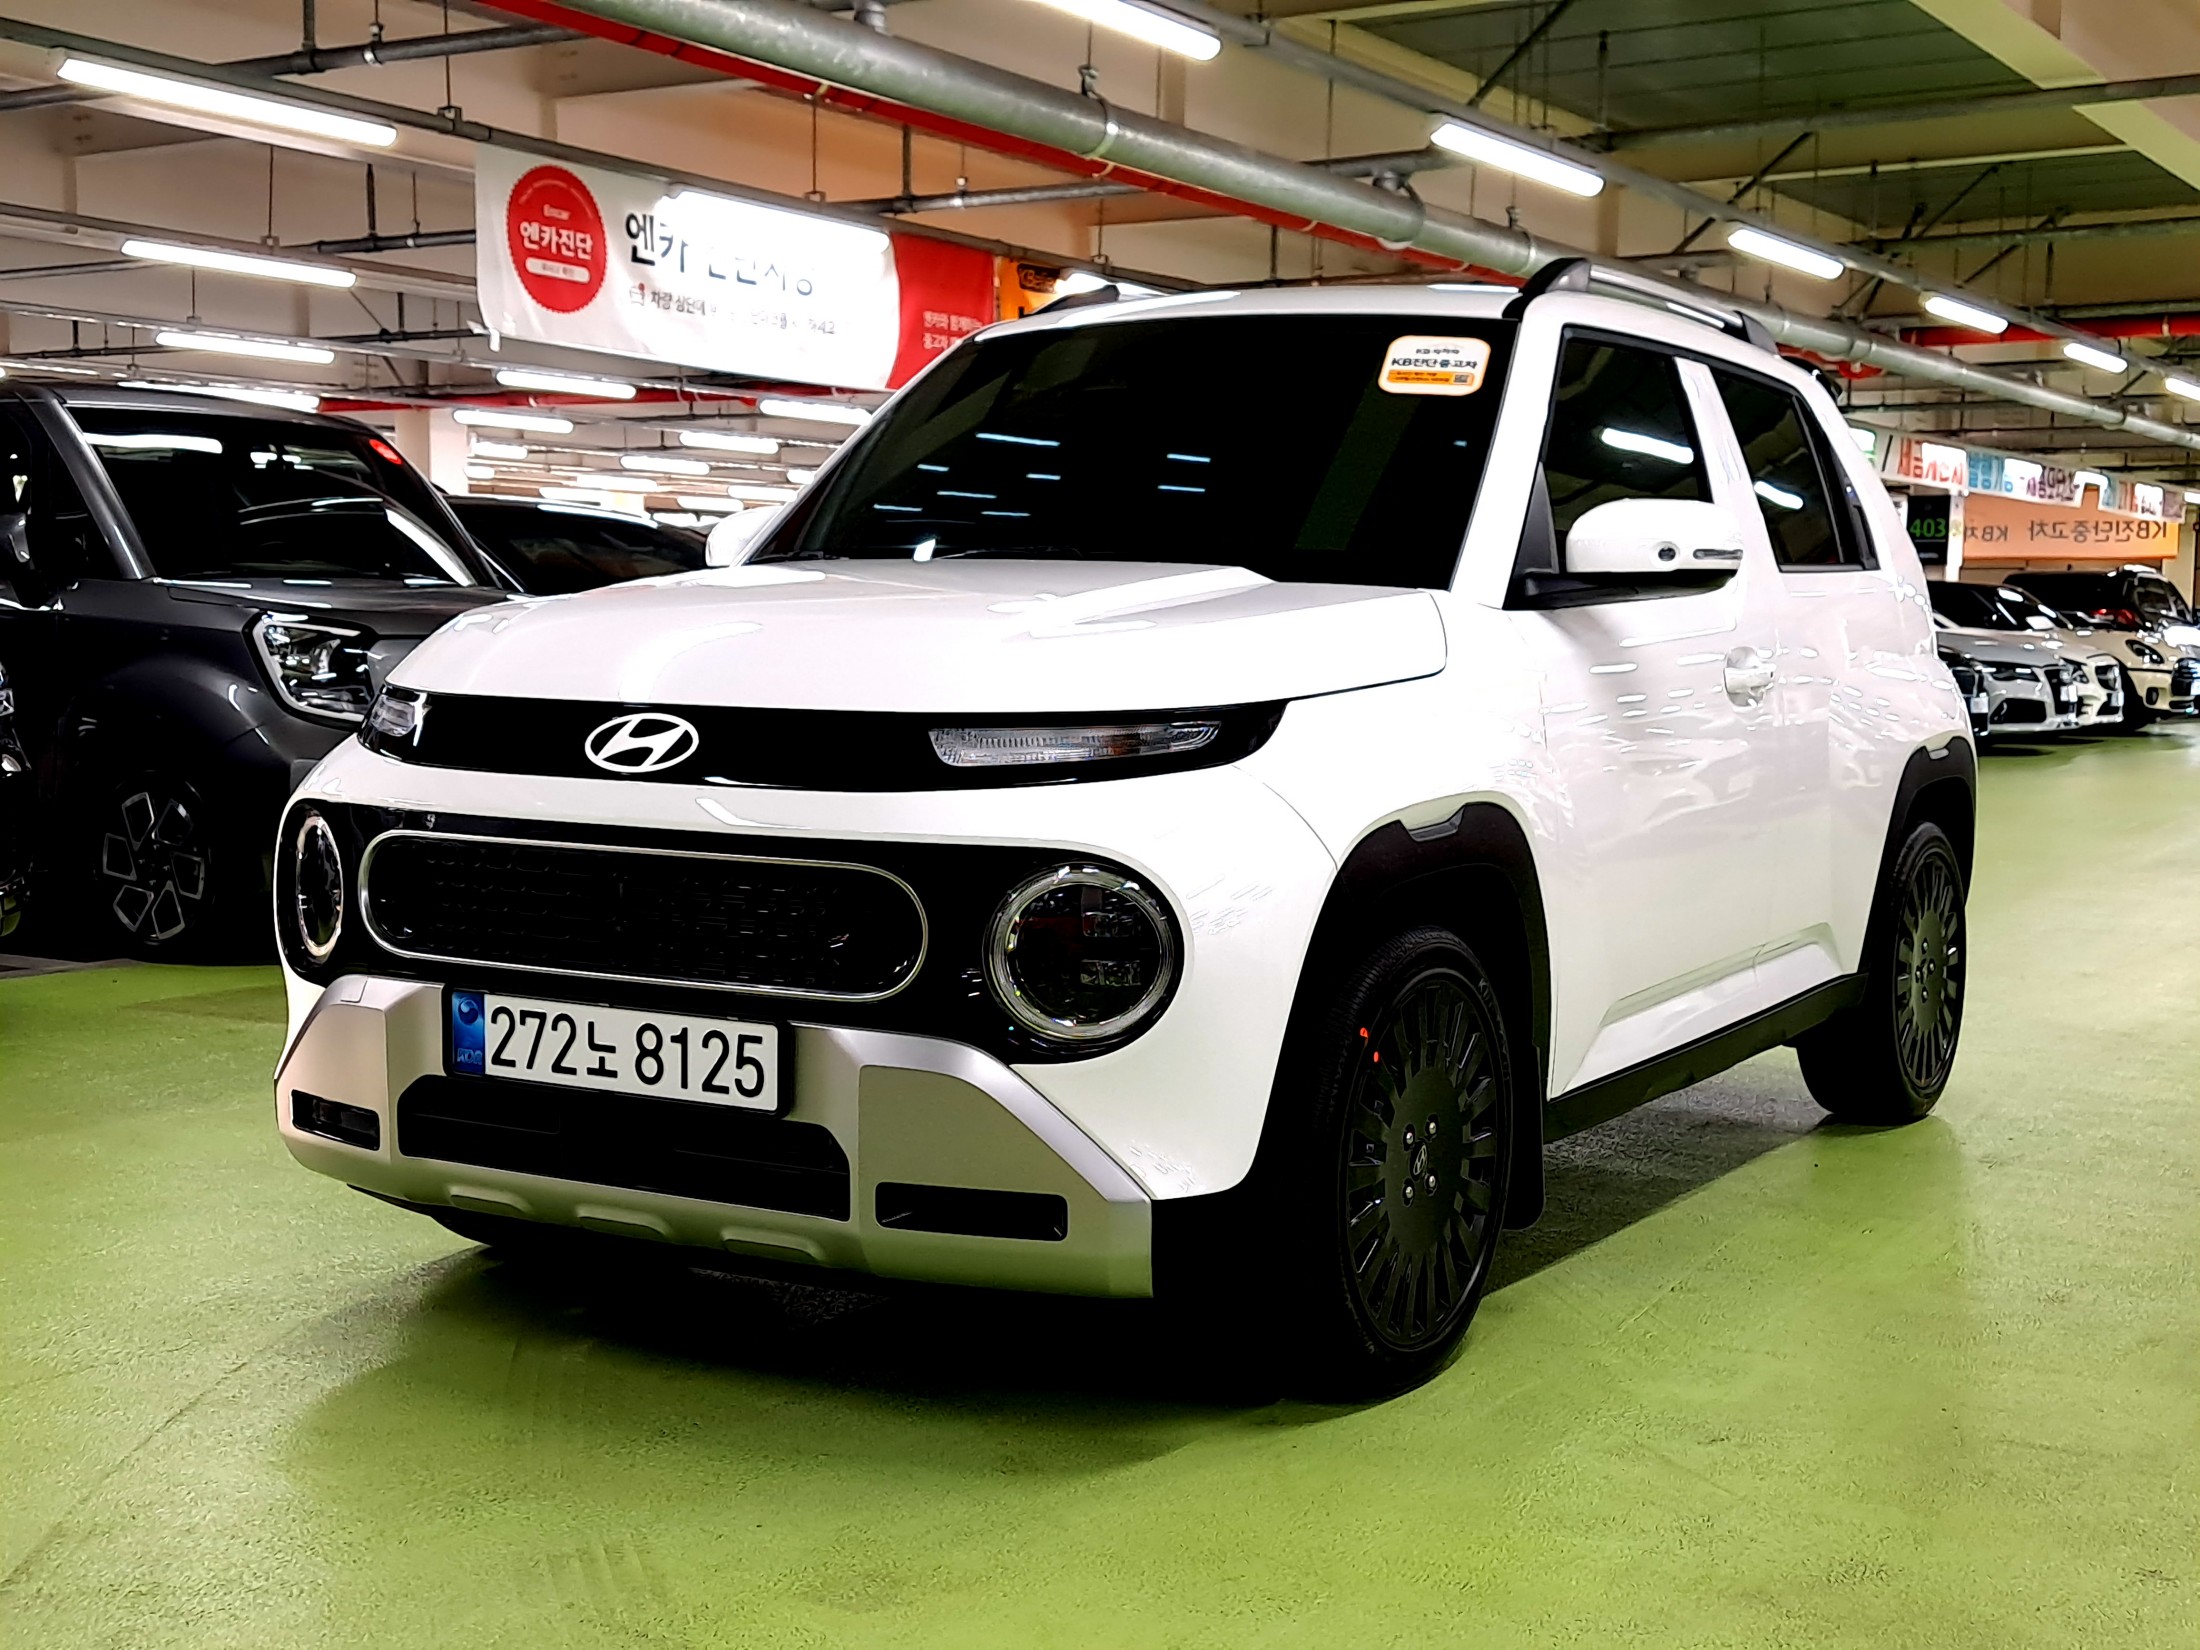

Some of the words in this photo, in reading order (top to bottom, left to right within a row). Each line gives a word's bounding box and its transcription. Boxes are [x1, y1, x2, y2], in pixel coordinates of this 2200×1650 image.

[519, 221, 594, 260] 엔카진단
[650, 289, 673, 311] 차량
[1910, 517, 1946, 538] 403
[490, 1005, 618, 1079] 272노
[634, 1022, 765, 1098] 8125
